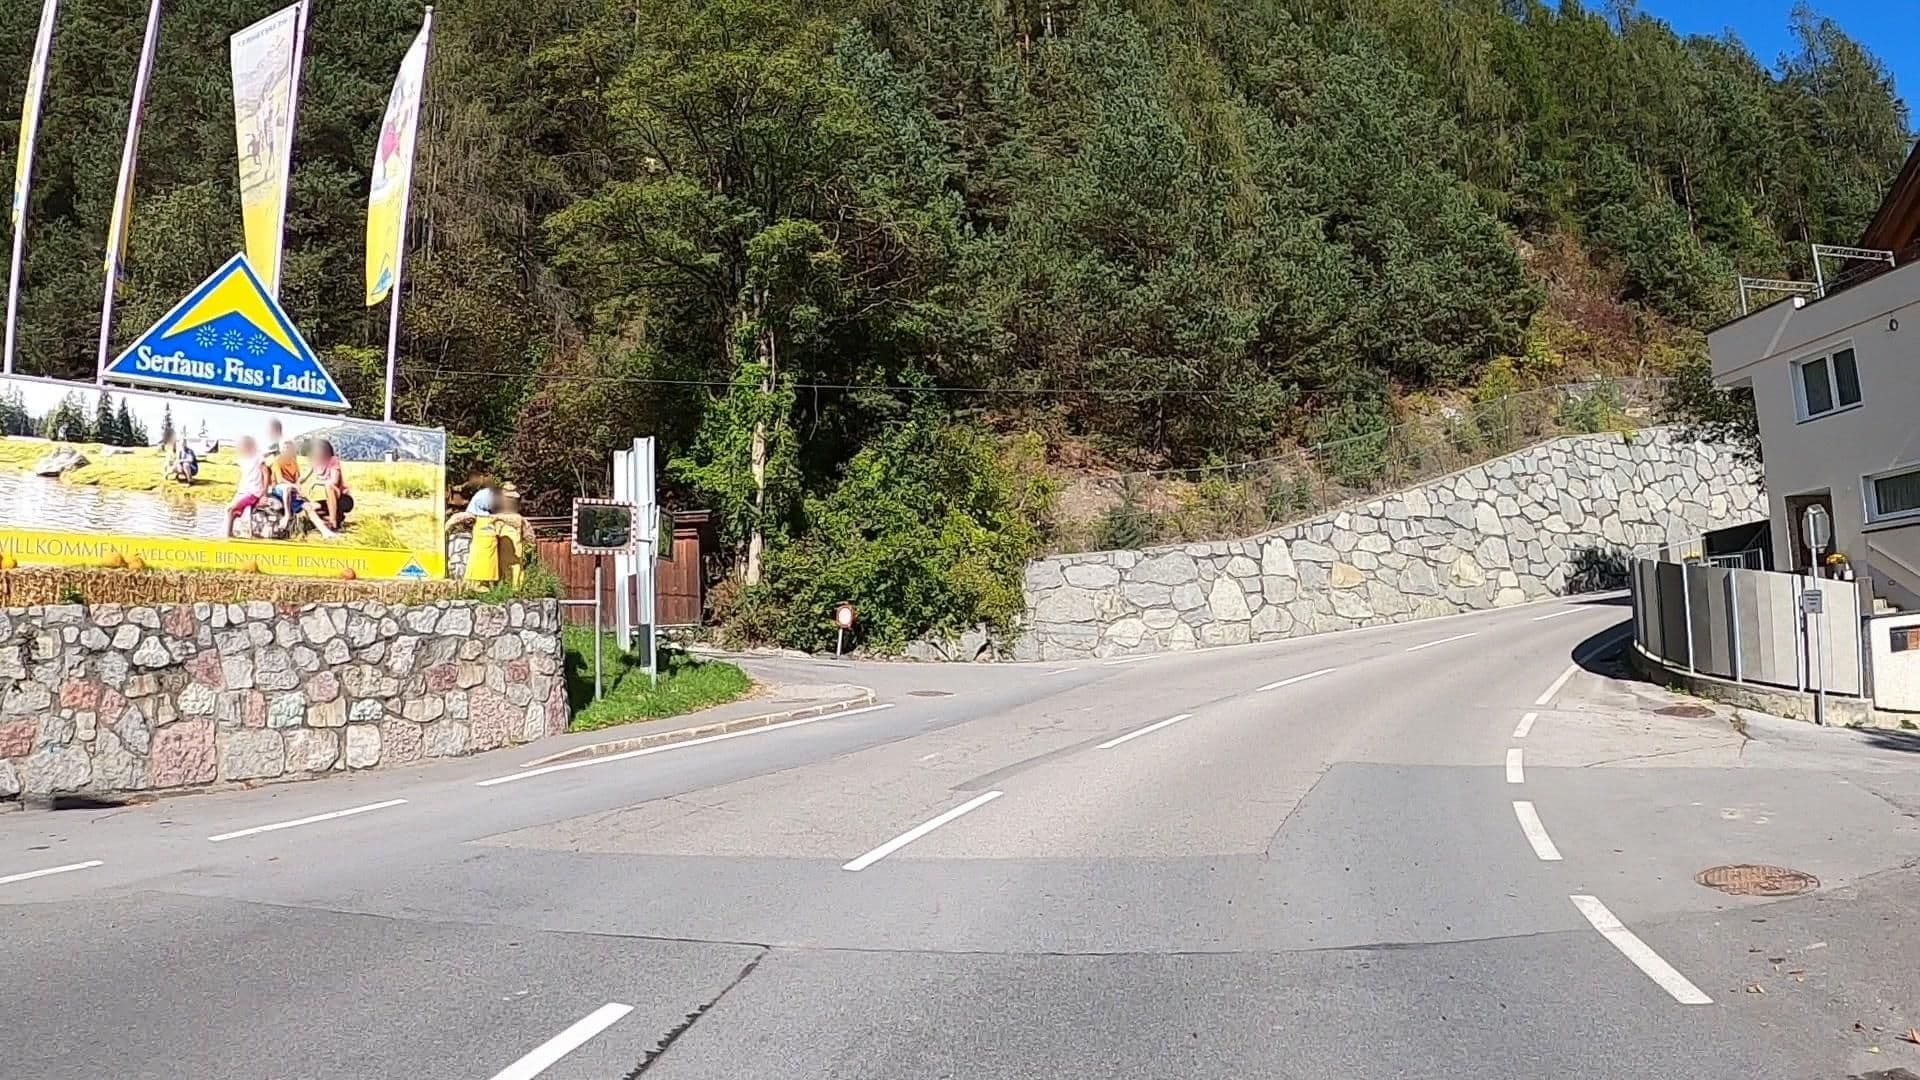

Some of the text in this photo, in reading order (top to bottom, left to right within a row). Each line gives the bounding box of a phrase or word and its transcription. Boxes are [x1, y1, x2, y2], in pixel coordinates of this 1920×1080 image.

[136, 345, 328, 395] Serfaus Fiss Ladis
